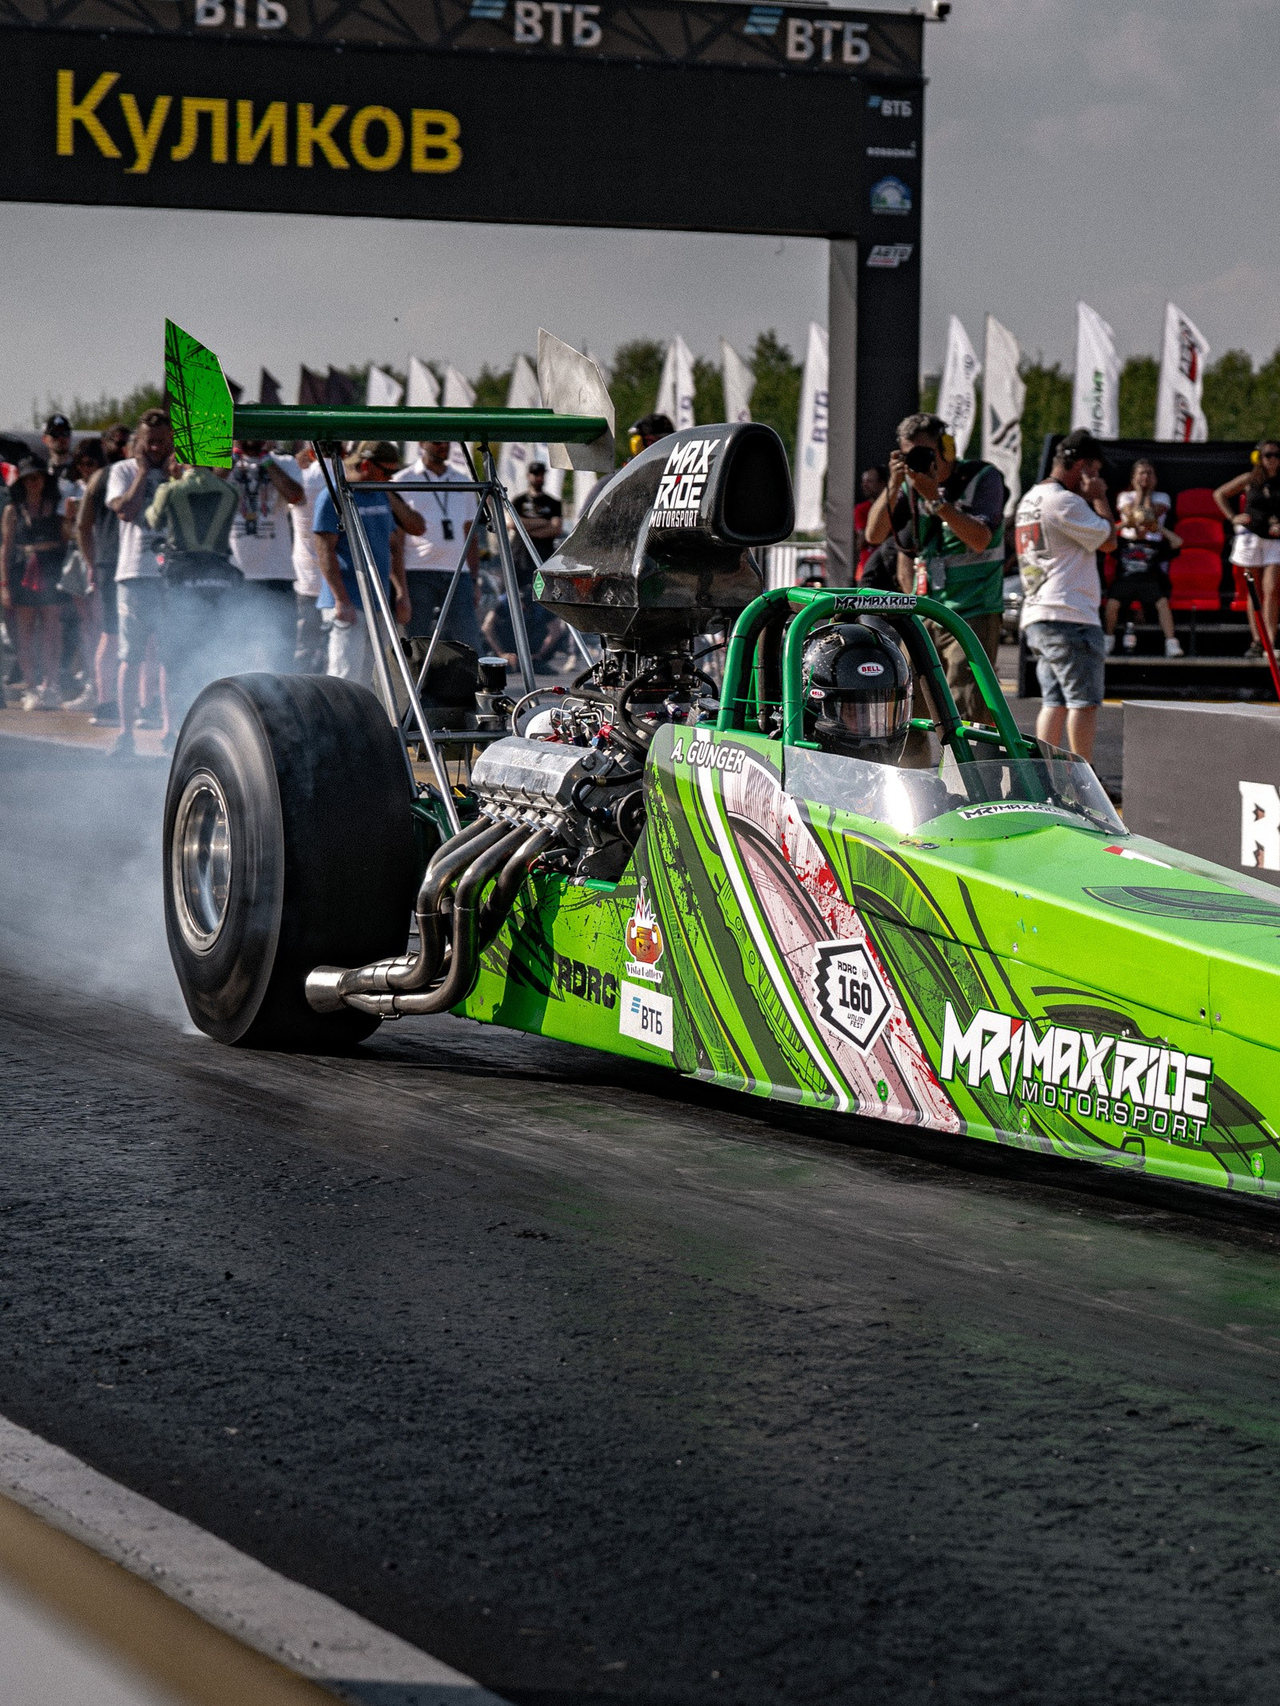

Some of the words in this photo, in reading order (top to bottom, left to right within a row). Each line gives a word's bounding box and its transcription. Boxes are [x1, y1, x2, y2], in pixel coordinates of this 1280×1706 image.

[514, 2, 601, 47] ВТБ
[786, 18, 871, 64] ВТБ
[56, 69, 463, 174] Куликов
[881, 100, 912, 117] ВТБ
[663, 438, 721, 475] MAX
[653, 473, 707, 510] RIDE
[648, 510, 699, 528] MOTORSPORT
[671, 737, 684, 763] A.
[687, 740, 747, 773] GUNGER
[556, 954, 617, 1010] RDRC
[837, 960, 857, 975] RDRC
[838, 974, 872, 1016] 160
[641, 1005, 663, 1036] ВТБ
[850, 1020, 863, 1030] FEST
[1022, 1080, 1206, 1142] MOTORSPORT
